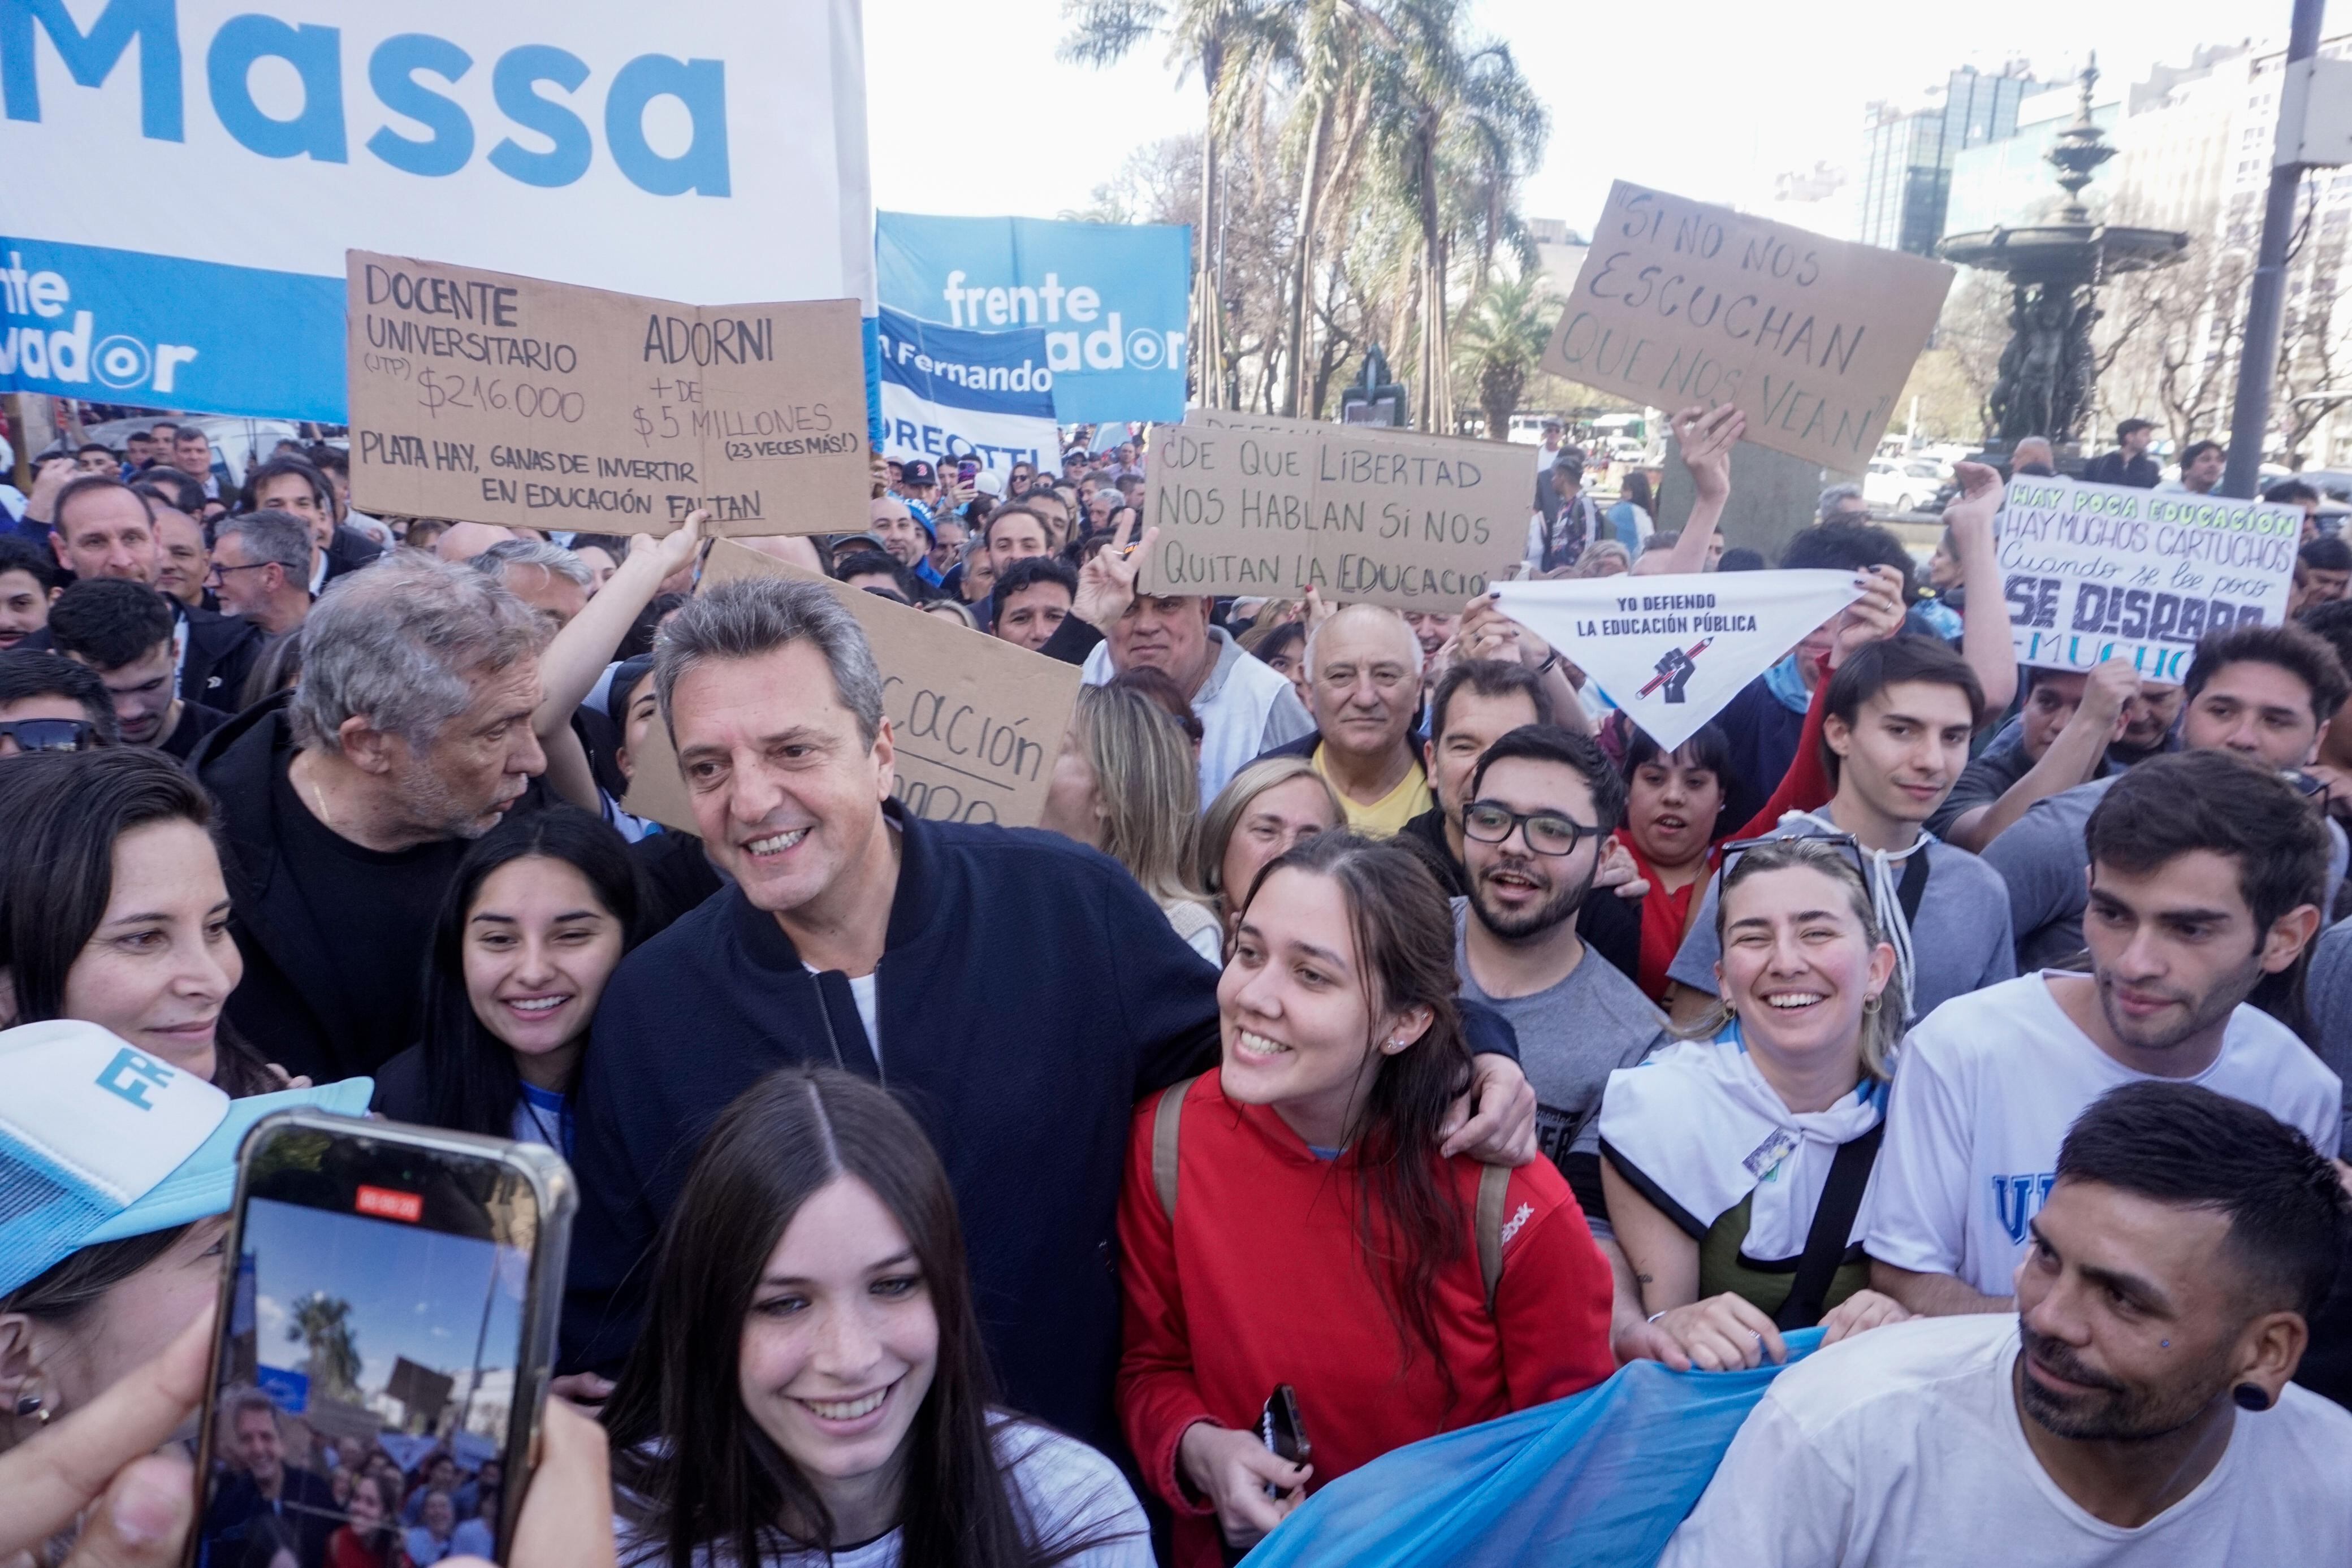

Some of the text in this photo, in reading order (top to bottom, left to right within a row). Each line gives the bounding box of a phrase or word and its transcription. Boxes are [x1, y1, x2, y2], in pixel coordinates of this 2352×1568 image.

[0, 0, 731, 198] Massa
[1674, 213, 1724, 259] NO
[1741, 235, 1821, 287] NOS
[365, 263, 517, 327] DOCENTE
[943, 270, 1100, 327] frente
[1589, 251, 1865, 376] ESCUCHAN
[366, 314, 577, 374] UNIVERSITARIO
[643, 314, 773, 366] ADORNI
[898, 341, 1053, 392] Fernando
[1561, 311, 1656, 382] QUE
[1658, 348, 1742, 410] NOS
[417, 366, 585, 423] $216.000
[675, 379, 702, 403] DE
[692, 403, 832, 439] MILLONES
[361, 430, 698, 483] PLATA HAY, GANAS DE INVERTIR
[725, 440, 753, 461] (23
[755, 439, 805, 456] VECES
[1240, 440, 1300, 477] QUE
[482, 478, 517, 504] EN
[526, 483, 651, 514] EDUCACIÓN
[1157, 484, 1225, 526] NOS
[1242, 488, 1364, 532] HABLAN
[1425, 510, 1490, 545] NOS
[2011, 483, 2065, 509] HAY
[2073, 490, 2139, 519] POCA
[2005, 508, 2294, 573] HAY MUCHOS CARTUCHOS
[1295, 553, 1327, 587] LA
[2001, 540, 2122, 579] Cuando
[2171, 561, 2203, 590] lee
[2211, 575, 2275, 598] poco
[1577, 613, 1757, 636] LA EDUCACIÓN PÚBLICA
[1617, 594, 1717, 612] YO DEFIENDO
[2004, 574, 2061, 628] SE
